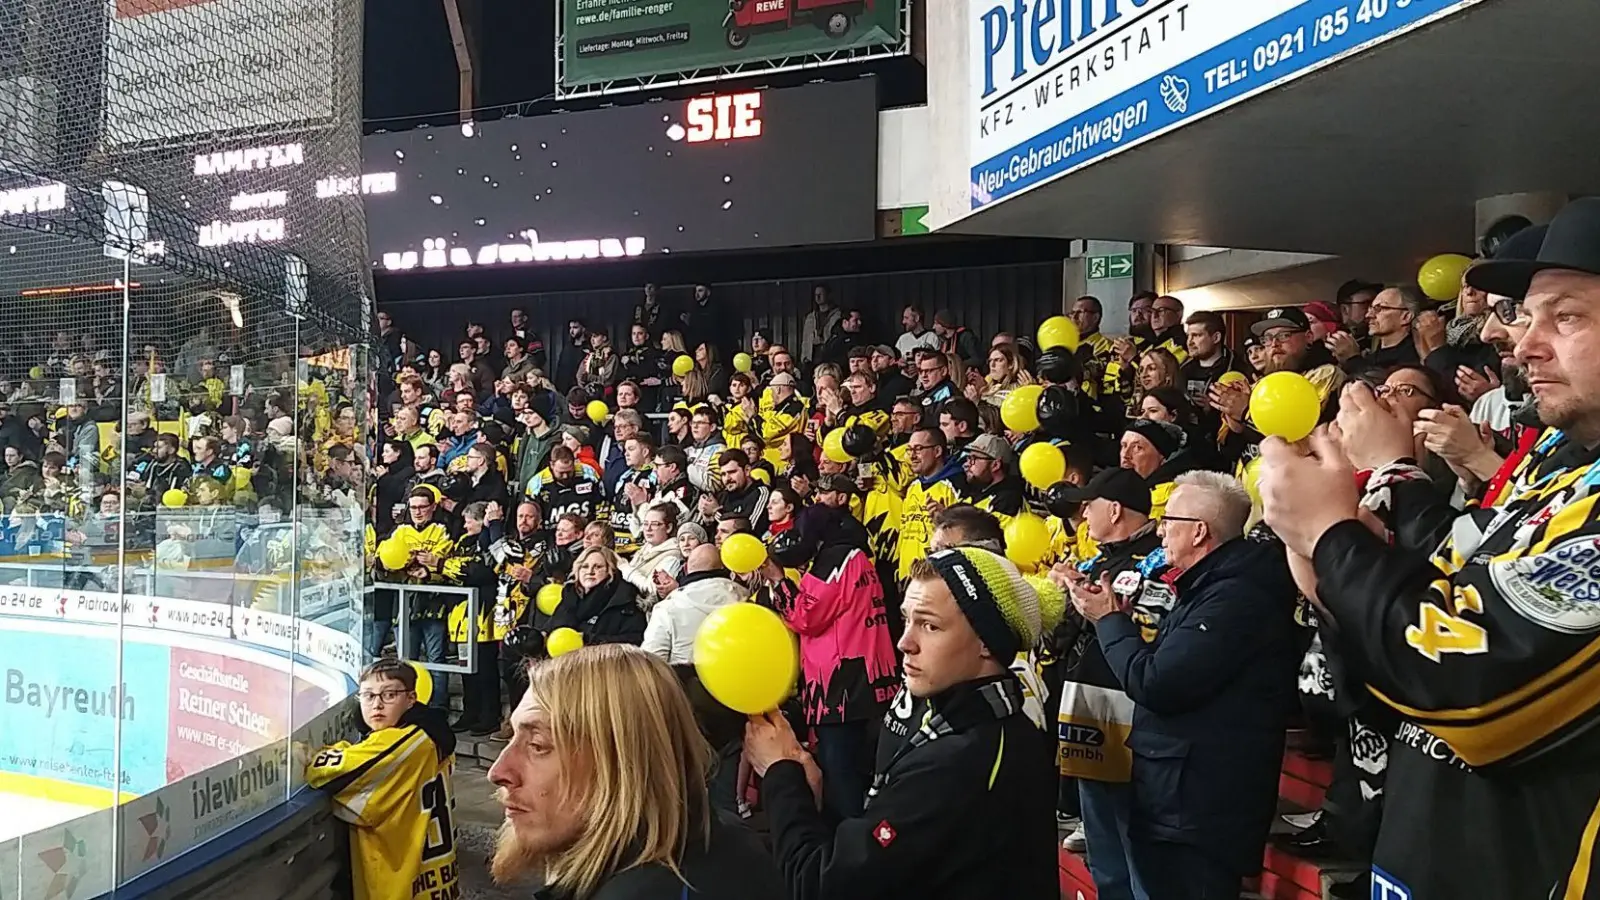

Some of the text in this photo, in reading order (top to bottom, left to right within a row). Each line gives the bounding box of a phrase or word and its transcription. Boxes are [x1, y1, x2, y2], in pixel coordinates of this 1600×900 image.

[576, 2, 674, 25] rewe.de/familie-renger
[756, 0, 785, 12] REWE
[579, 31, 688, 53] Liefertage: Montag, Mittwoch, Freitag
[1203, 60, 1247, 94] TEL:
[1253, 27, 1304, 72] 0921
[687, 92, 762, 143] SIE
[978, 99, 1148, 197] Neu-Gebrauchtwagen
[77, 595, 135, 614] Piotrowki
[5, 668, 135, 721] Bayreuth
[178, 687, 272, 738] Reiner Scheer
